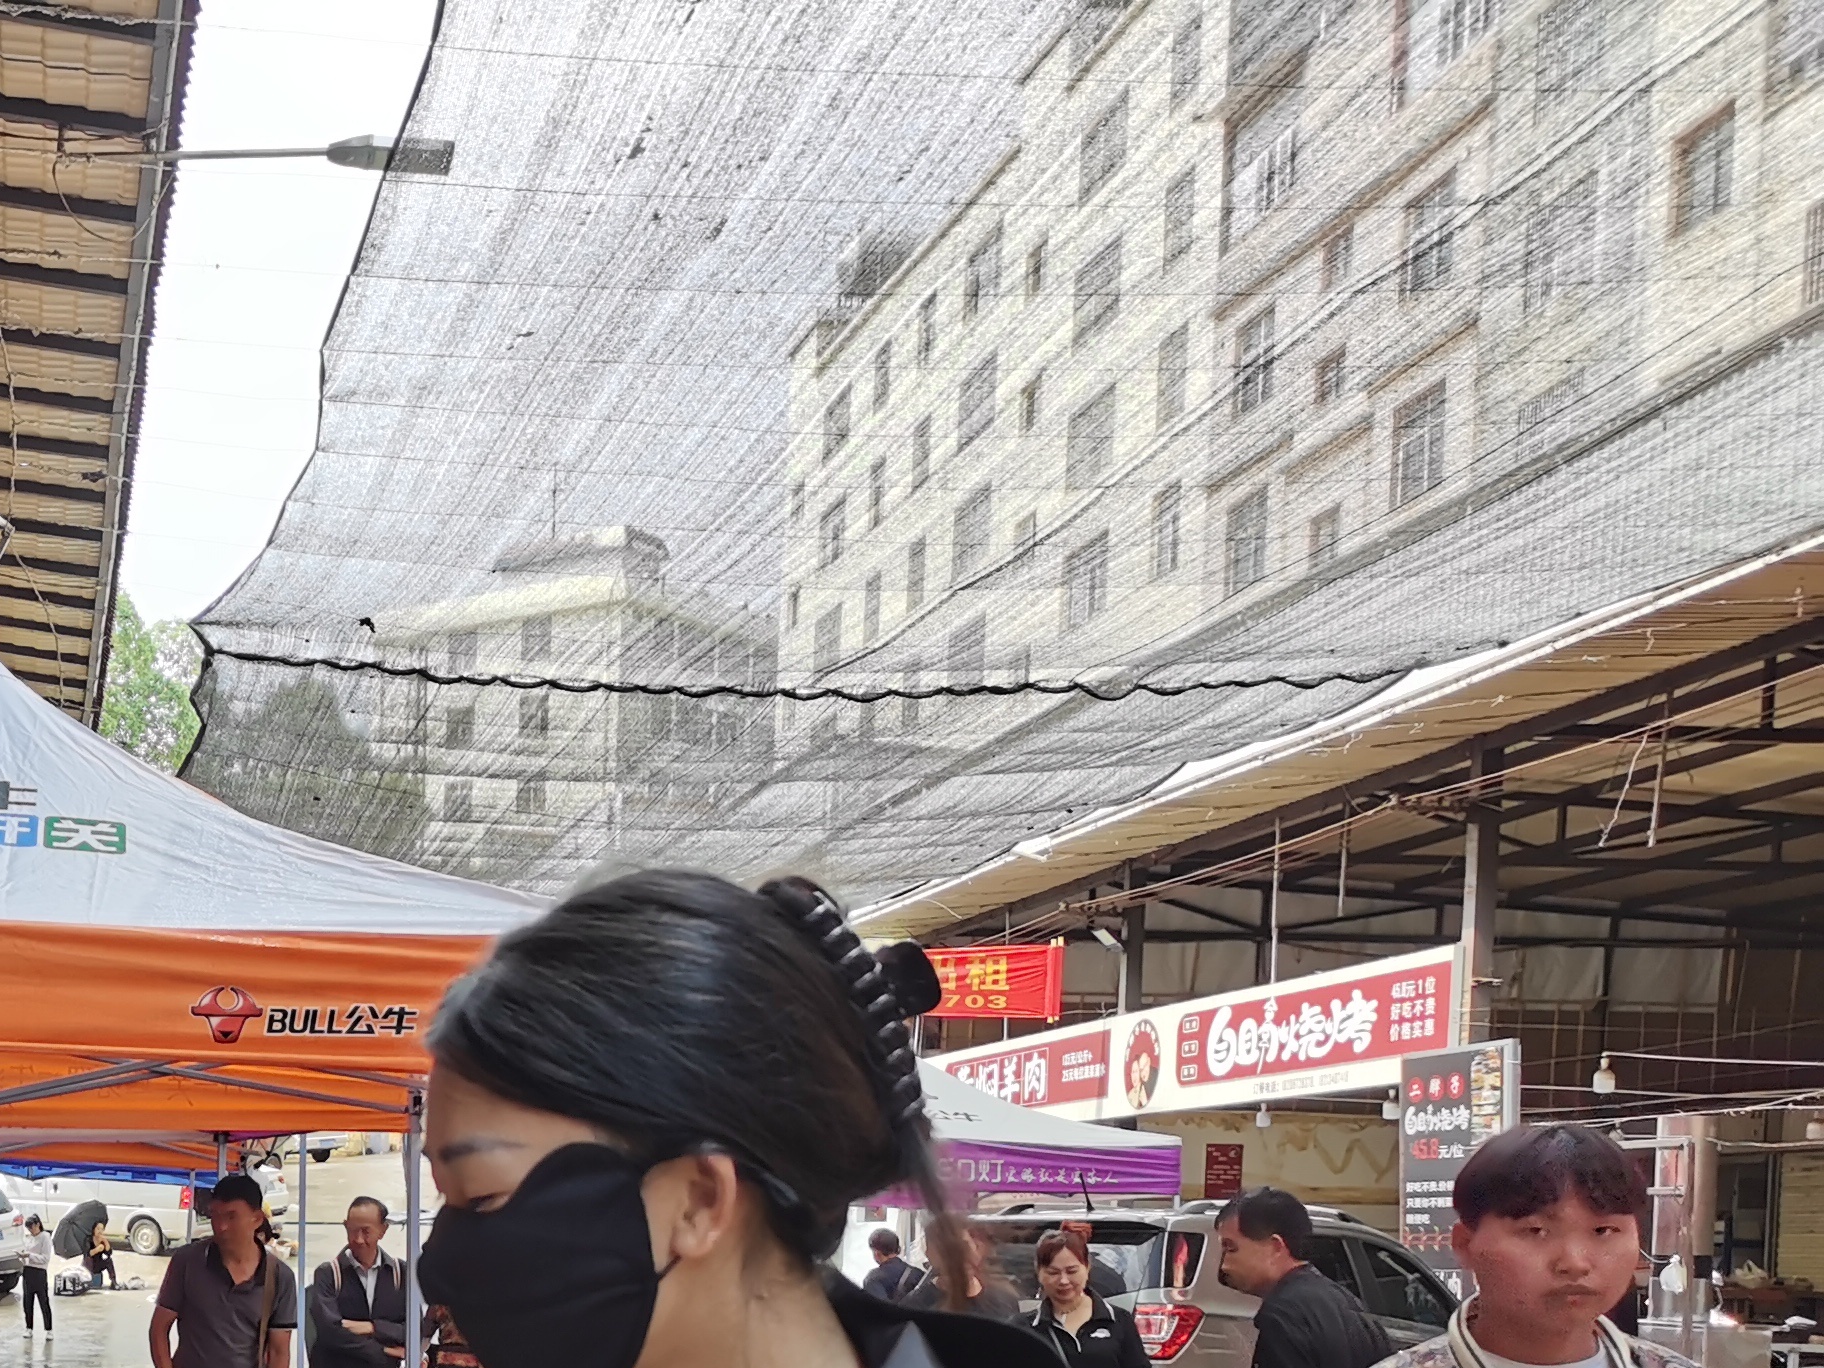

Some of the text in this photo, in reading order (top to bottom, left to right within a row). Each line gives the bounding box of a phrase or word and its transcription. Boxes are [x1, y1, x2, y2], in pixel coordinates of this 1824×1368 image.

[1207, 989, 1378, 1076] 自助烧烤
[1408, 1075, 1462, 1099] 二胖子
[1405, 1103, 1471, 1136] 自助烧烤
